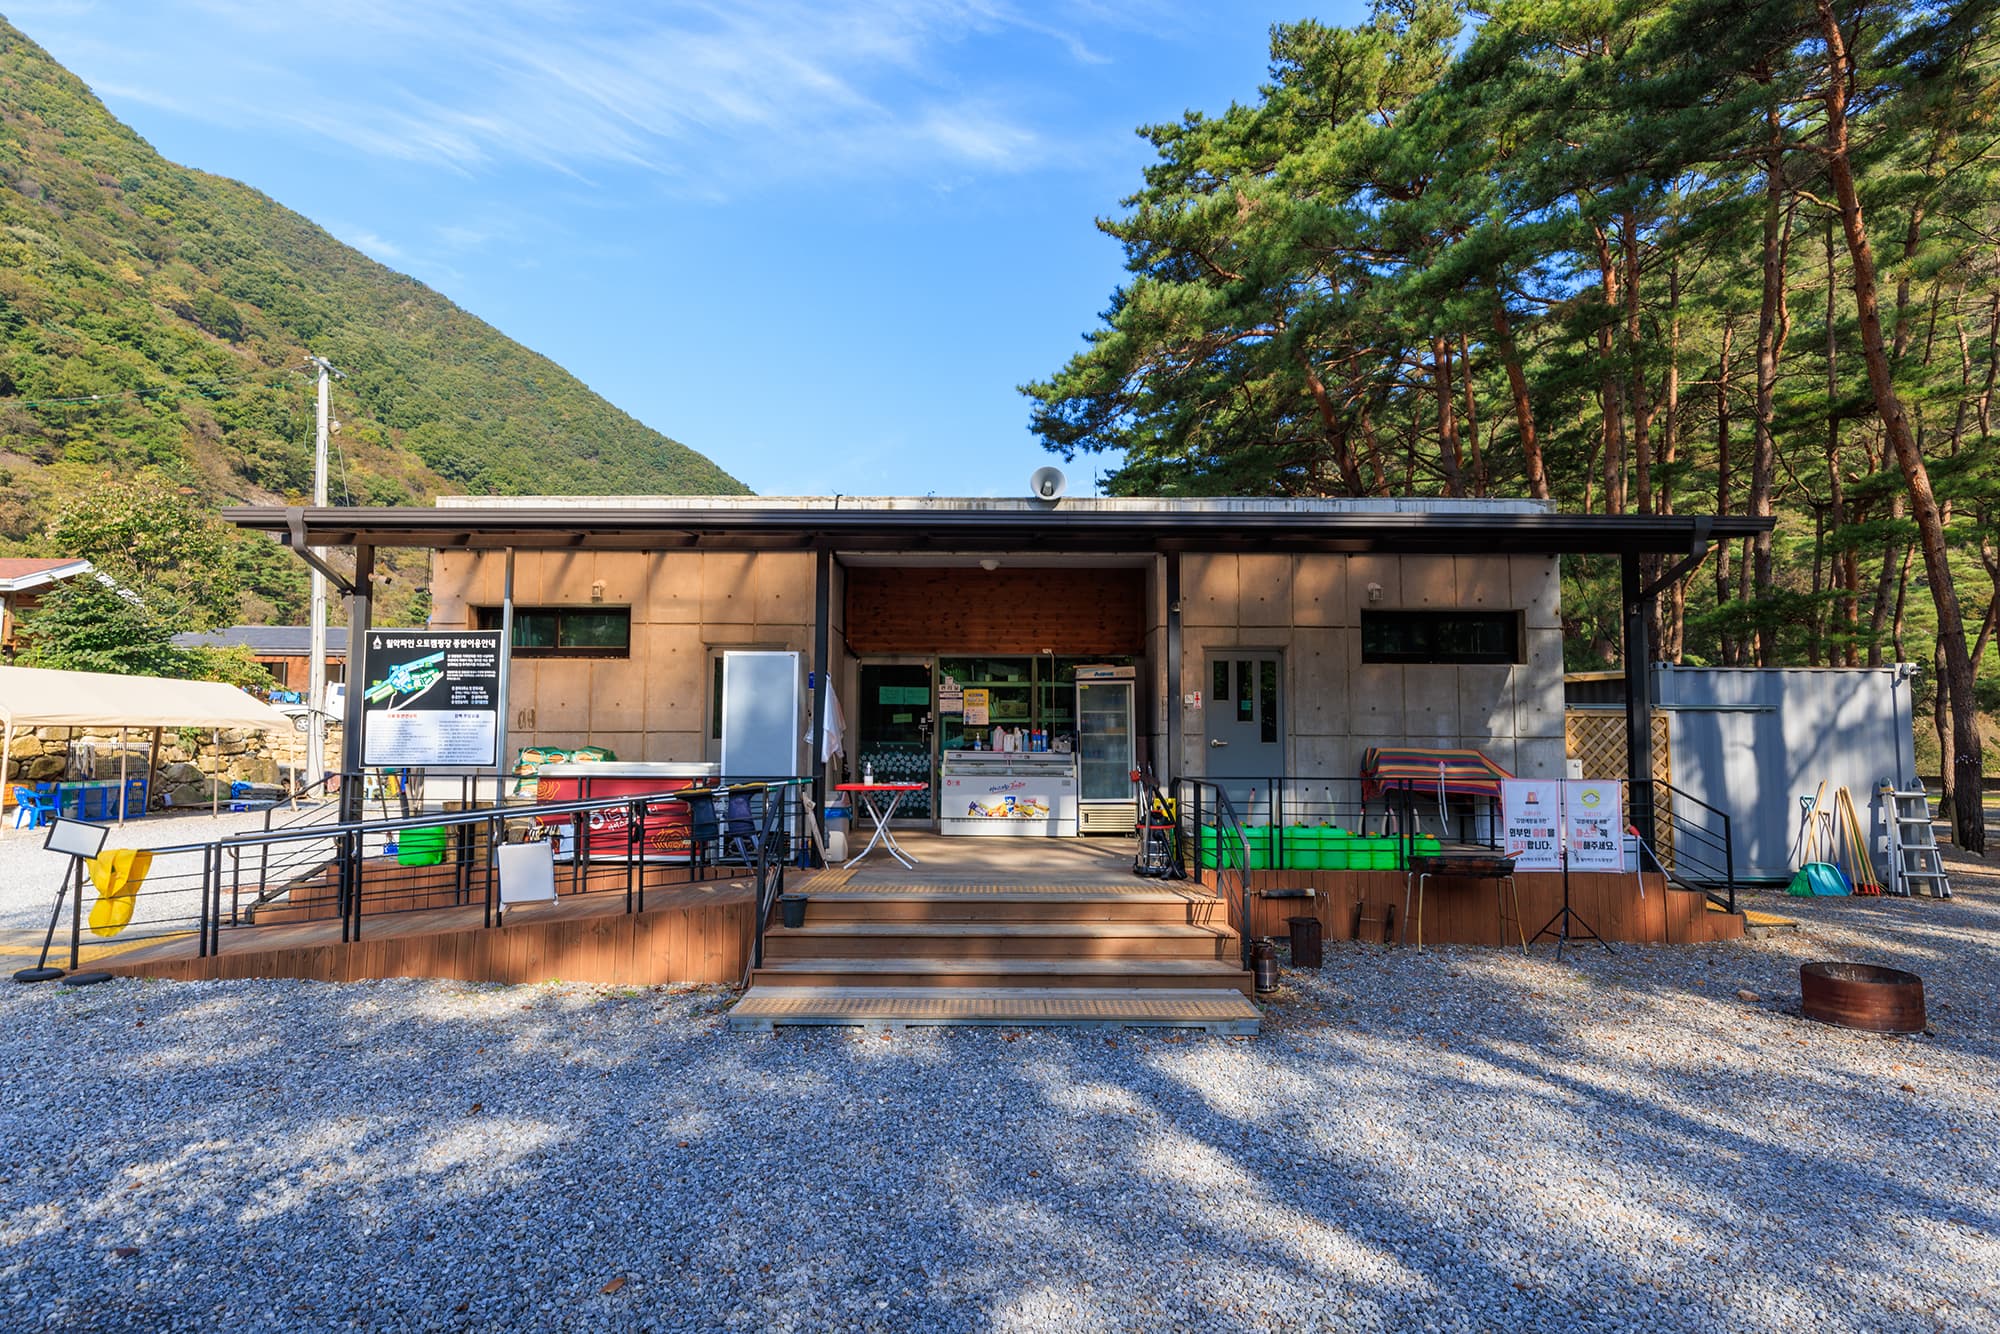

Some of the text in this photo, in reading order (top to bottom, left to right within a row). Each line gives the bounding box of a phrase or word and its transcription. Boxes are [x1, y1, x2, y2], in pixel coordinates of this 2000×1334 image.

[416, 639, 452, 649] 오토캠핑장
[453, 639, 496, 649] 종합이용안내
[1509, 828, 1555, 838] 외부인 출입을
[1600, 828, 1608, 838] 꼭
[1512, 840, 1553, 850] 금지합니다.
